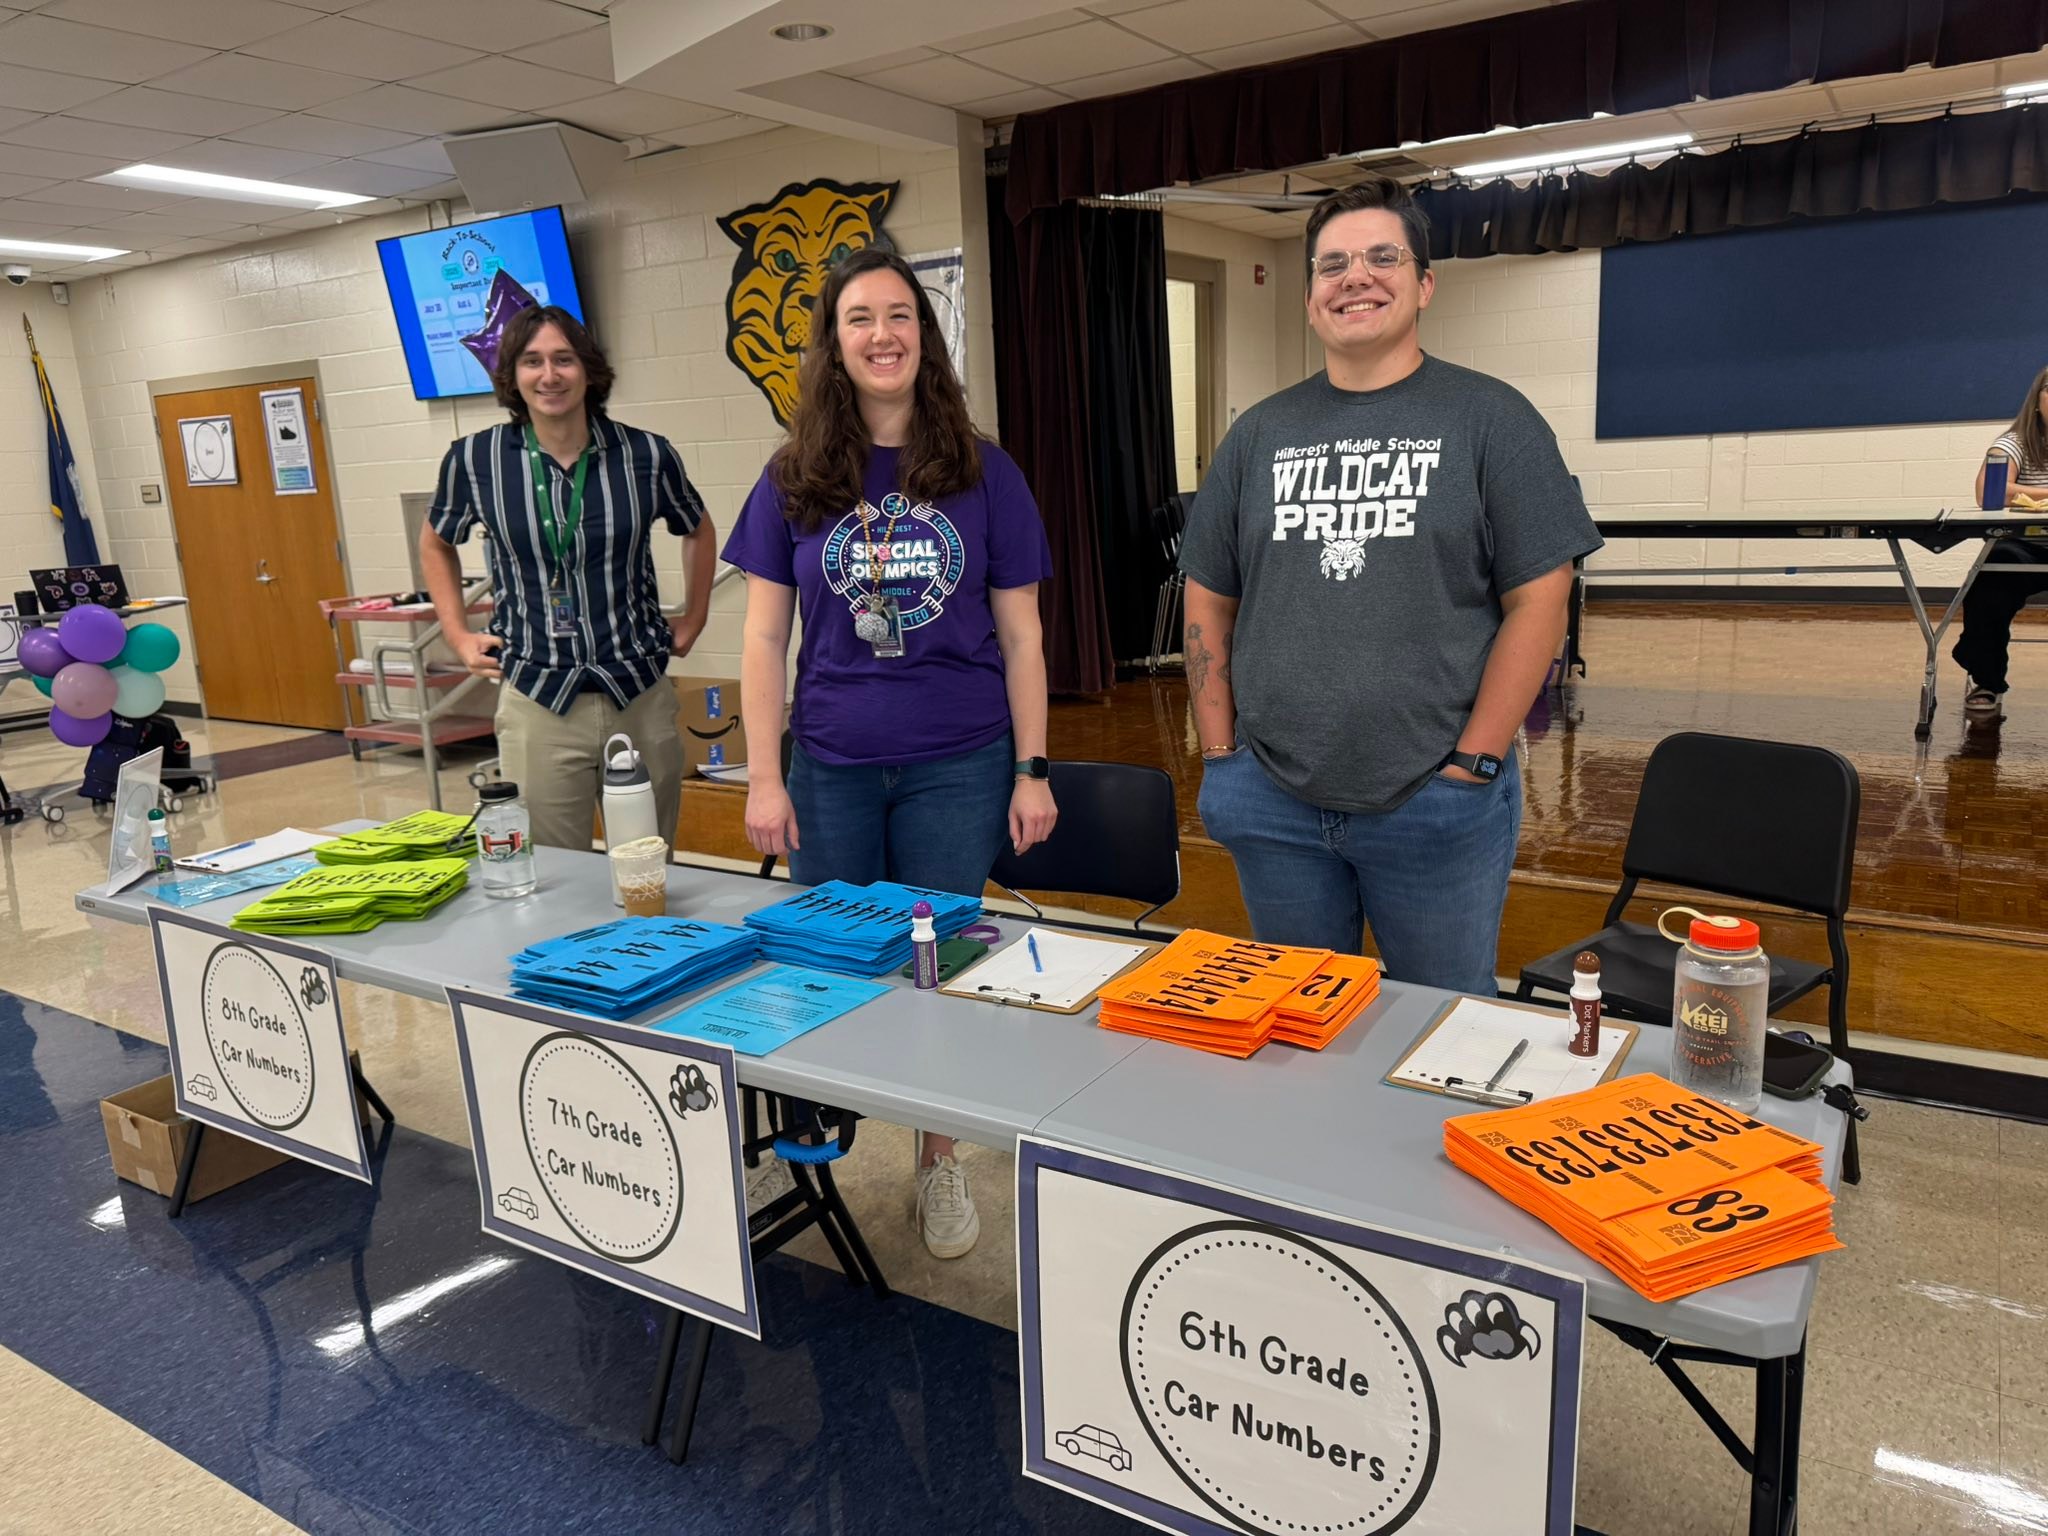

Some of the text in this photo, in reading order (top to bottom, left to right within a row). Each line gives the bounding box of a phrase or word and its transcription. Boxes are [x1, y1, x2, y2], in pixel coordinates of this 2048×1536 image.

[1274, 438, 1441, 461] Hillcrest Middle School
[1272, 453, 1440, 503] WILDCAT
[877, 525, 912, 533] HILREST
[1272, 499, 1417, 541] PRIDE
[827, 526, 850, 570] CARING
[932, 516, 961, 580] COMMITTED
[881, 588, 912, 597] MIDDLE
[222, 998, 287, 1036] 8th Grade
[1582, 1005, 1592, 1053] Dot Markers
[1693, 1012, 1728, 1029] REI
[221, 1040, 301, 1084] Car Numbers
[547, 1097, 643, 1147] 7th Grade
[547, 1149, 661, 1207] Car Numbers
[1179, 1311, 1370, 1398] 6th Grade
[1164, 1381, 1386, 1483] Car Numbers
